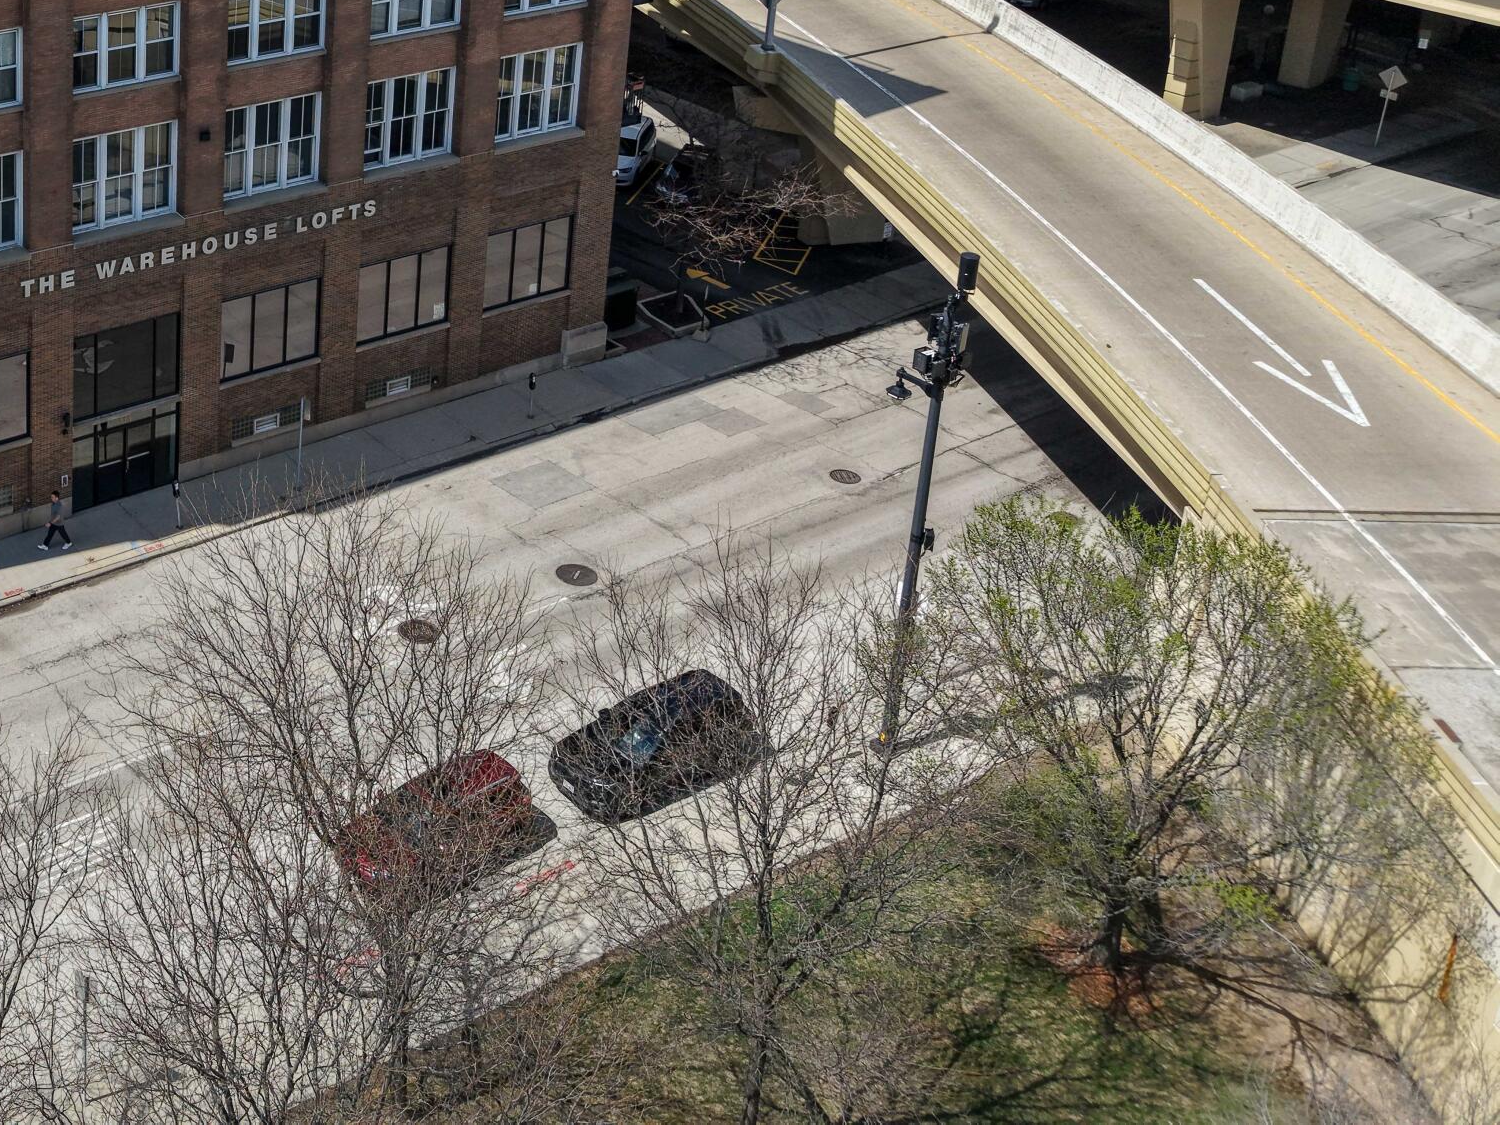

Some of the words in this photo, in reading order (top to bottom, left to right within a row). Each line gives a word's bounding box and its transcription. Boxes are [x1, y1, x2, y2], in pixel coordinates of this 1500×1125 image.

[20, 269, 76, 298] THE
[95, 222, 278, 280] WAREHOUSE
[296, 199, 377, 234] LOFTS
[704, 281, 810, 320] PRIVATE
